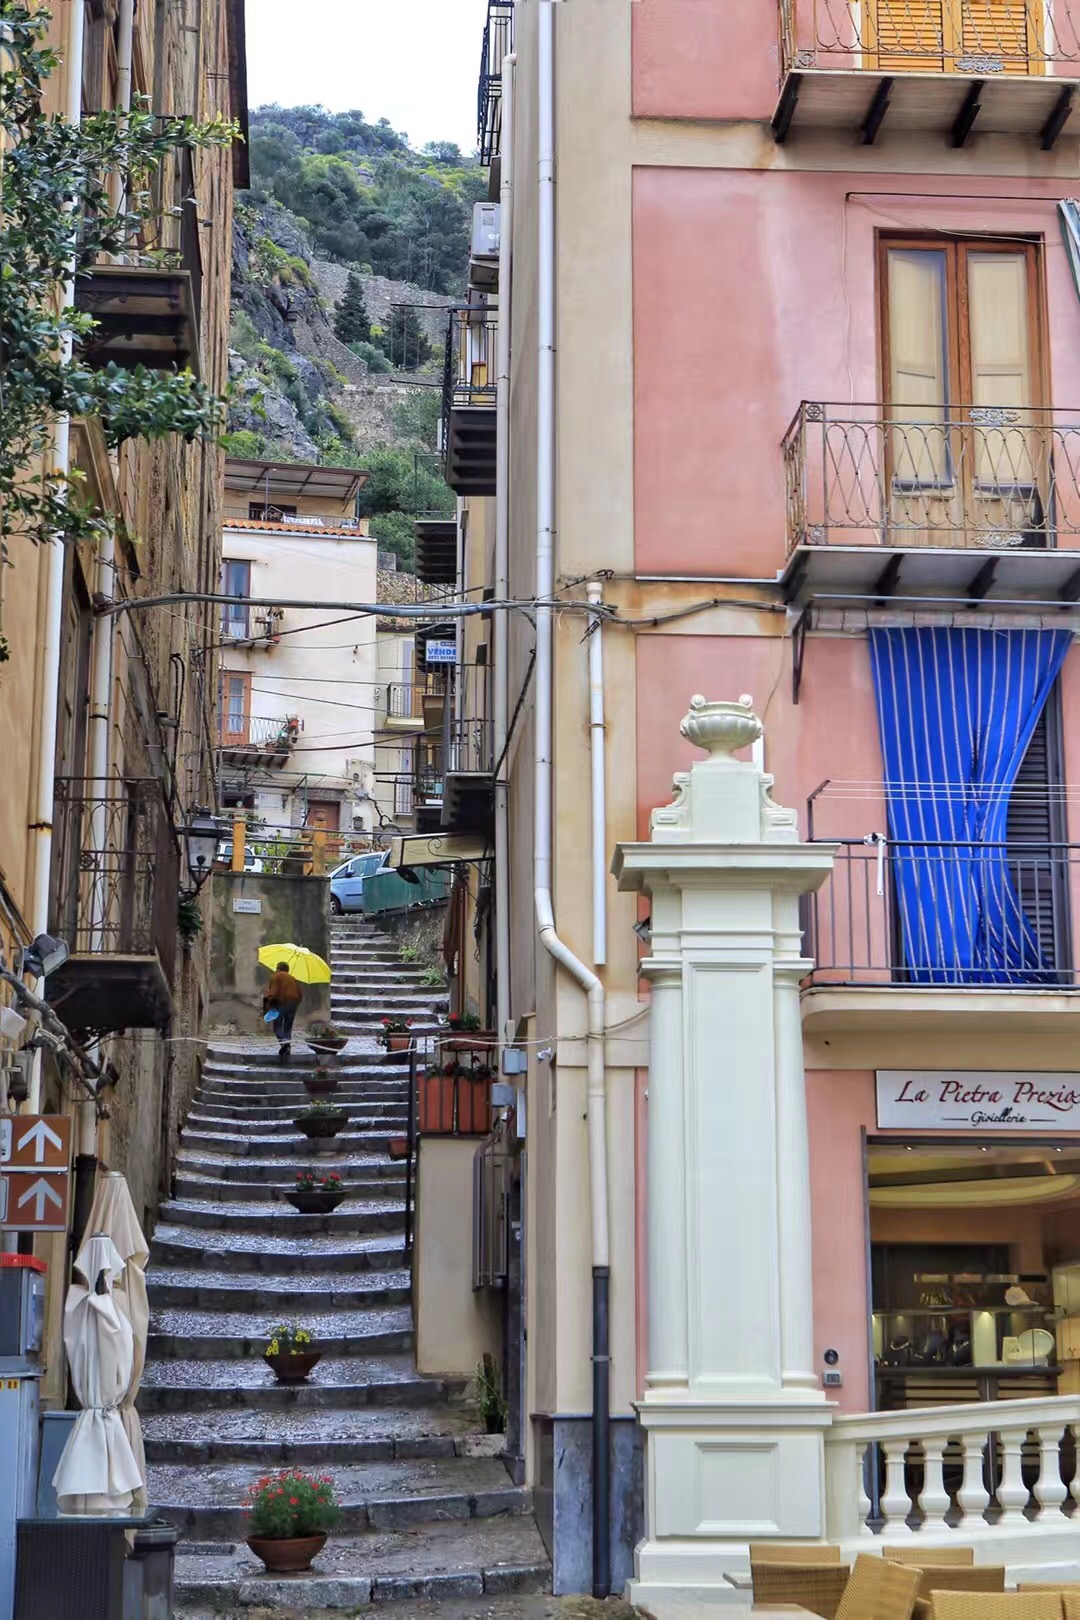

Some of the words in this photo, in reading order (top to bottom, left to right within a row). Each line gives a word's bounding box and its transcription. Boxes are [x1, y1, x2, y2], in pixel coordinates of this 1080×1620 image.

[895, 1080, 929, 1103] La
[939, 1080, 1003, 1103] Pietra
[970, 1107, 1027, 1127] Gioielleria
